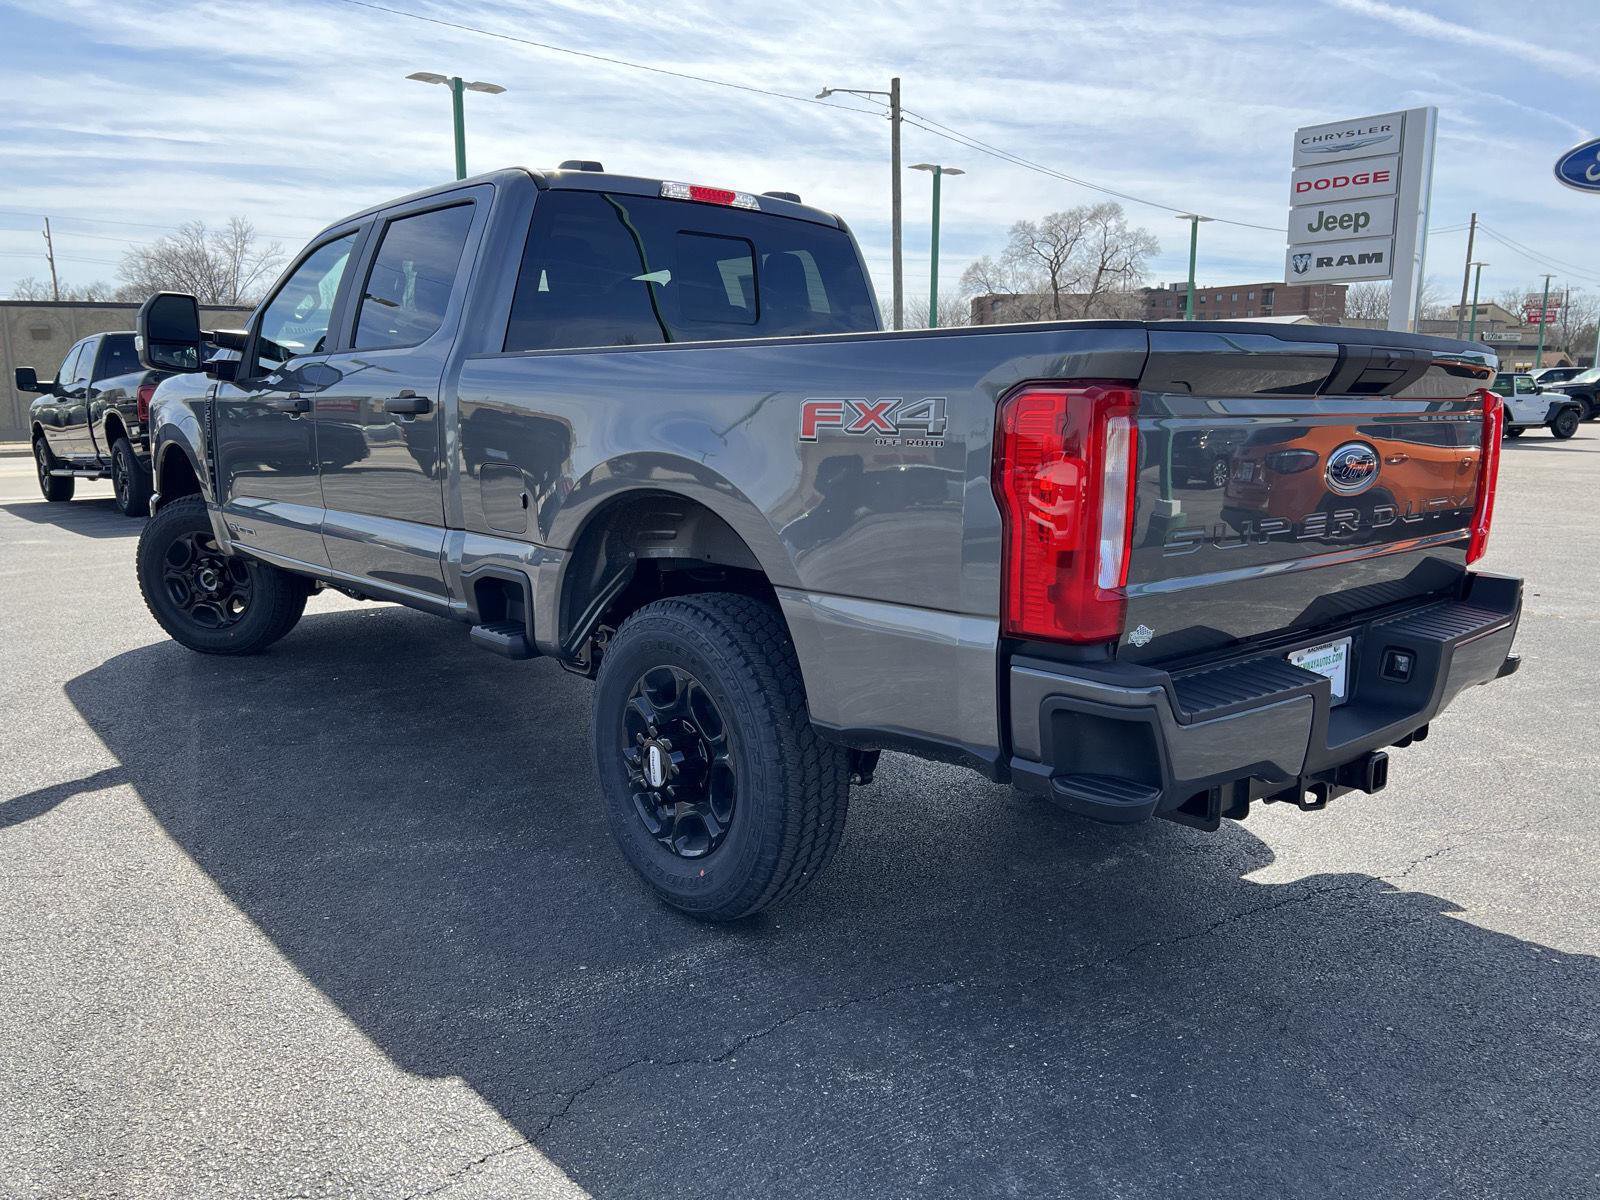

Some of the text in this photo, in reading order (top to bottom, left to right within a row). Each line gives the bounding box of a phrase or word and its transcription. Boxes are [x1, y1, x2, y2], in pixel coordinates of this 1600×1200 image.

[1301, 125, 1391, 145] CHRYSLER
[1296, 171, 1390, 193] DODGE
[1307, 211, 1370, 233] Jeep
[1316, 252, 1384, 268] RAM
[798, 397, 948, 443] FX4
[874, 438, 944, 447] OFF ROAD
[1163, 496, 1469, 557] SUPER DUTY
